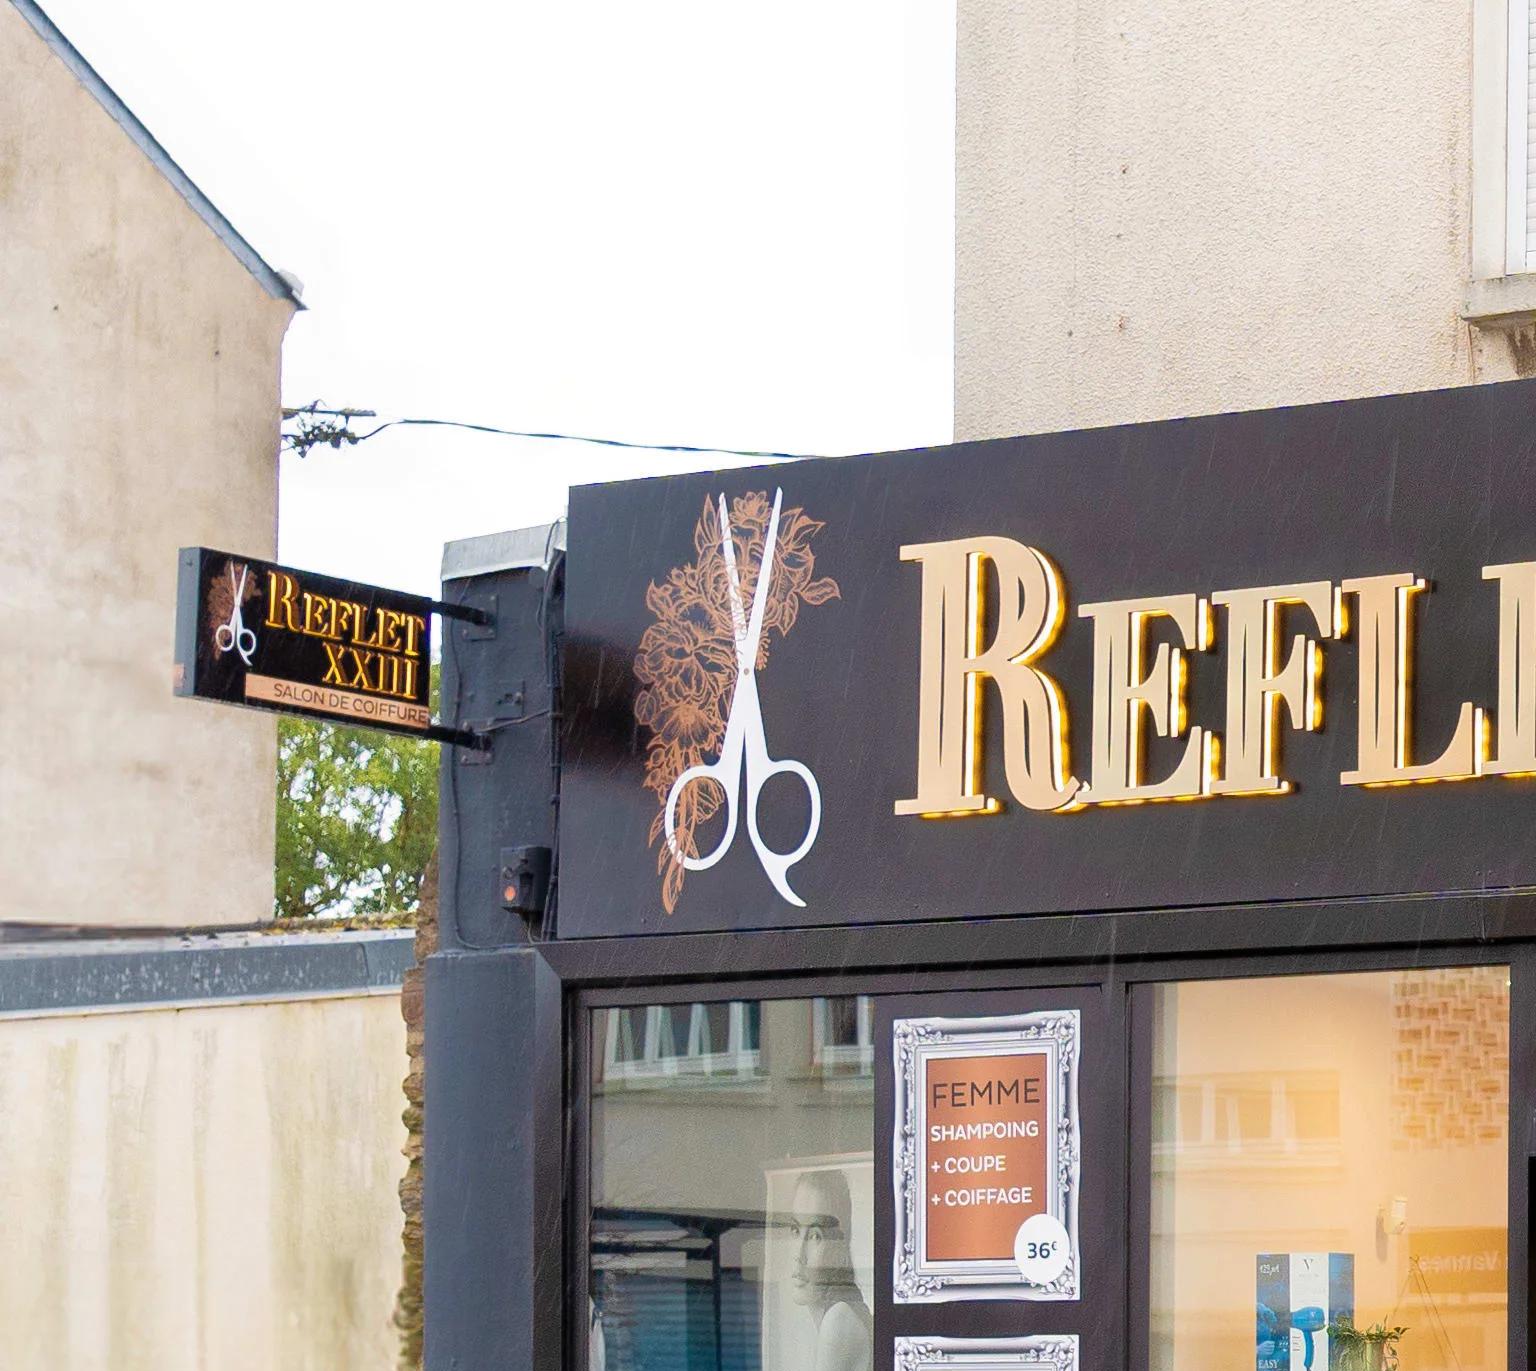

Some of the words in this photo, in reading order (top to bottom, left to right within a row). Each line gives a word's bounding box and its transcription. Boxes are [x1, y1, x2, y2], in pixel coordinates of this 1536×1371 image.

[321, 641, 421, 700] XXIII
[273, 683, 325, 705] SALON
[328, 692, 350, 709] DE
[352, 696, 429, 724] COIFFURE
[933, 1077, 1041, 1109] FEMME
[930, 1120, 1039, 1142] SHAMPOING
[944, 1155, 1007, 1175] COUPE
[944, 1187, 1033, 1207] COIFFAGE
